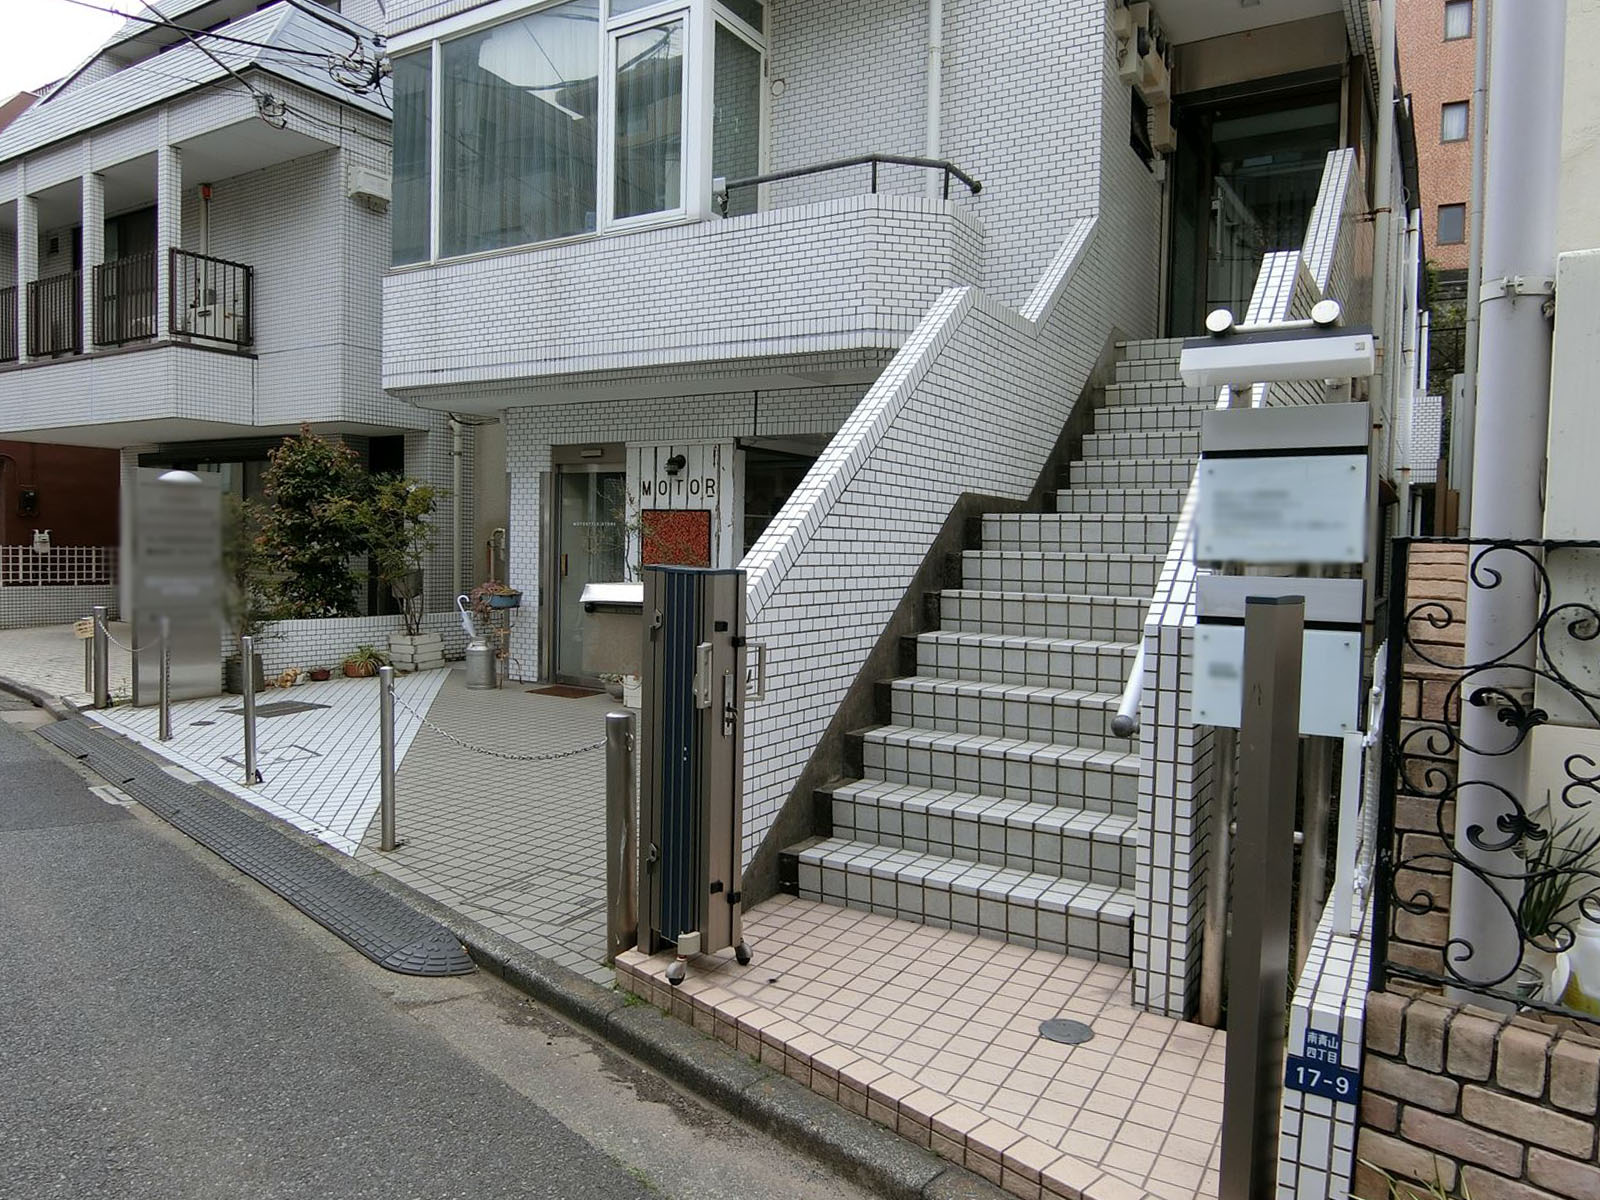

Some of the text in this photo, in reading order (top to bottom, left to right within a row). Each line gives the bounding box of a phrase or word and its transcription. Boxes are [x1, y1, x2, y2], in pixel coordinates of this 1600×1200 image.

[642, 478, 716, 496] MOTOR
[1307, 1031, 1339, 1049] 南青山
[1306, 1046, 1338, 1064] 四丁目
[1296, 1066, 1350, 1094] 17-9
